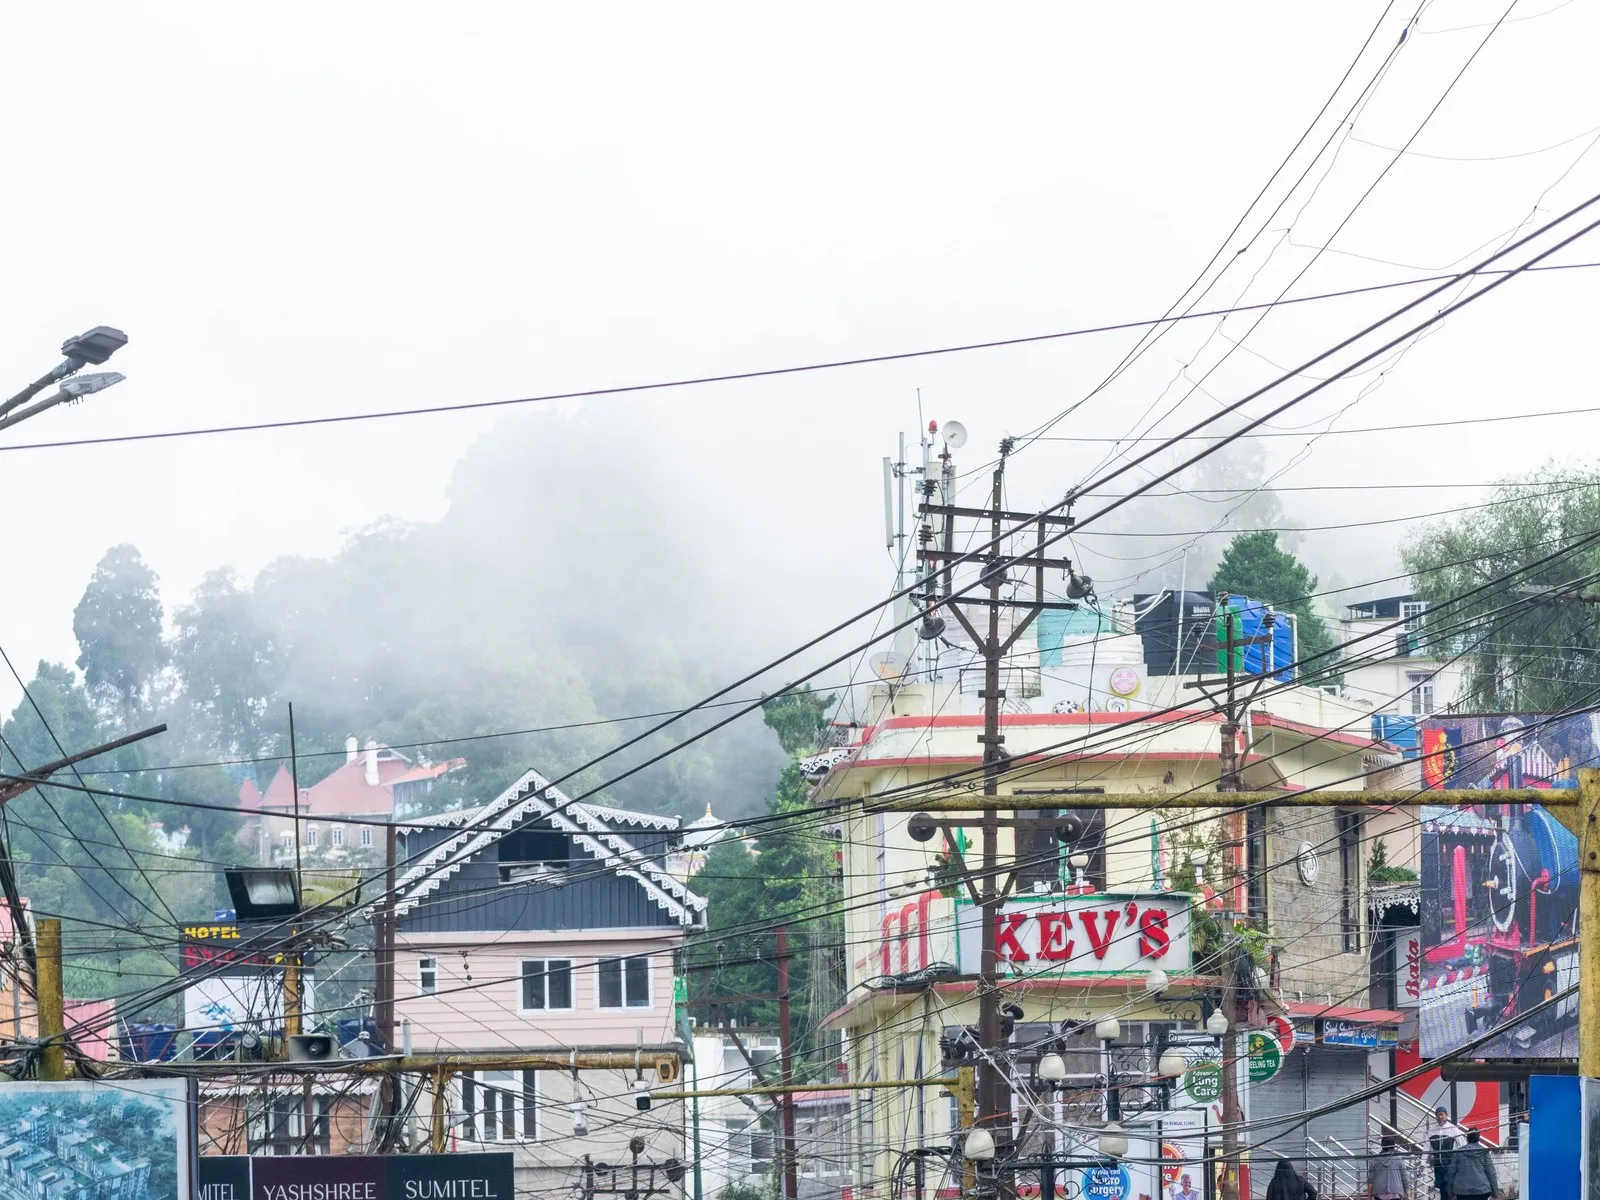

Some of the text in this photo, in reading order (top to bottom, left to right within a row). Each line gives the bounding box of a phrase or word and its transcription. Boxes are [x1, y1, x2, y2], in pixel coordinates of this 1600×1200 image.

[185, 927, 240, 939] HOTEL
[994, 902, 1170, 960] KEV'S
[1406, 938, 1420, 999] Bata
[1266, 1059, 1276, 1068] TEA
[1192, 1076, 1218, 1086] Lung
[1193, 1087, 1217, 1095] Care
[405, 1179, 498, 1199] SUMITEL
